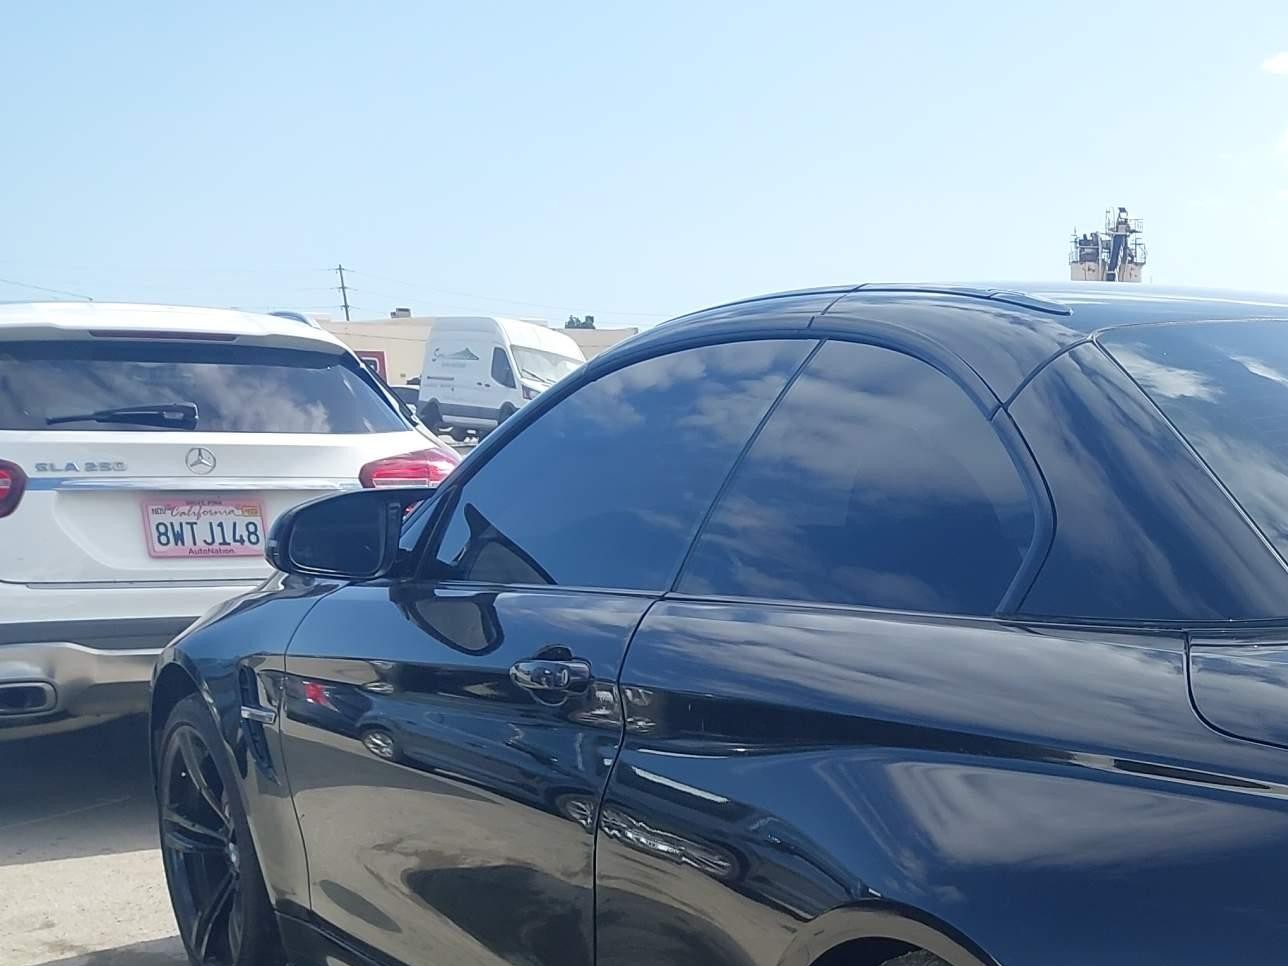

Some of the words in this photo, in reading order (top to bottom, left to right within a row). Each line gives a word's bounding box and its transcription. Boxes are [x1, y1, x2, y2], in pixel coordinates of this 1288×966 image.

[35, 462, 80, 472] SLA
[84, 462, 128, 472] 250
[169, 505, 240, 520] California
[155, 521, 260, 547] 8WTJ148
[188, 547, 235, 555] AutoNation
